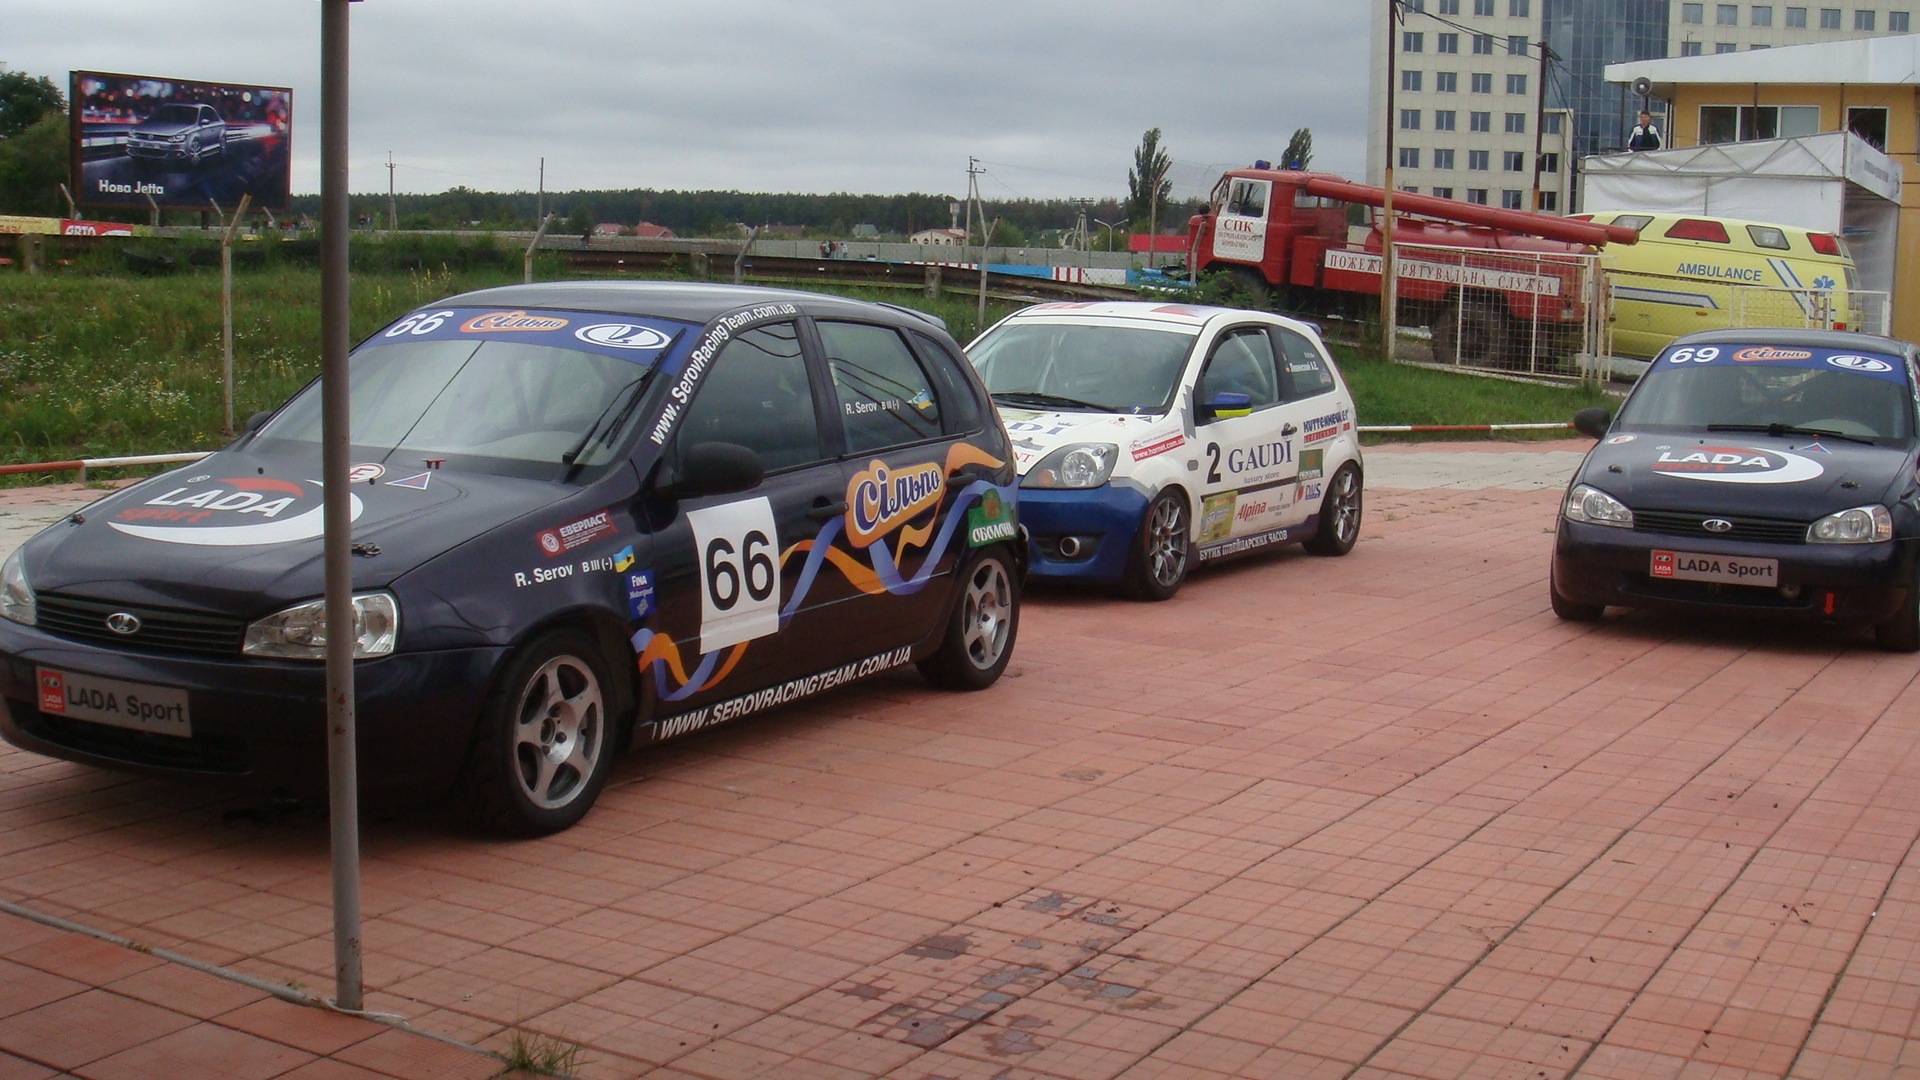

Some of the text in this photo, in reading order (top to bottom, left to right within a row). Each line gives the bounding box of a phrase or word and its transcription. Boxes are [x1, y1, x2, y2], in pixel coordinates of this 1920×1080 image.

[99, 180, 164, 194] Нова Jetta
[1224, 219, 1254, 232] СПК
[1676, 263, 1763, 282] AMBULANCE
[1498, 275, 1552, 294] СЛУЖБА
[385, 311, 454, 338] 66
[1669, 347, 1720, 364] 69
[855, 401, 877, 414] Serov
[1206, 442, 1222, 485] 2
[1228, 440, 1293, 474] GAUDI
[1658, 452, 1771, 468] LADA
[1244, 471, 1280, 484] luxury store
[144, 487, 296, 518] LADA
[853, 467, 942, 536] Сільпо
[1236, 501, 1267, 521] Alpina
[115, 507, 213, 523] sport
[559, 513, 607, 537] ЕВЕРЛАСТ
[1200, 545, 1221, 560] БУТИК
[1268, 530, 1288, 543] ЧАСОВ
[515, 572, 532, 588] R.
[533, 564, 574, 583] Serov
[706, 530, 774, 611] 66
[1678, 559, 1773, 577] LADA Sport
[67, 684, 185, 723] LADA Sport
[660, 645, 912, 740] WWW.SEROVRACINGTEAM.COM.UA
